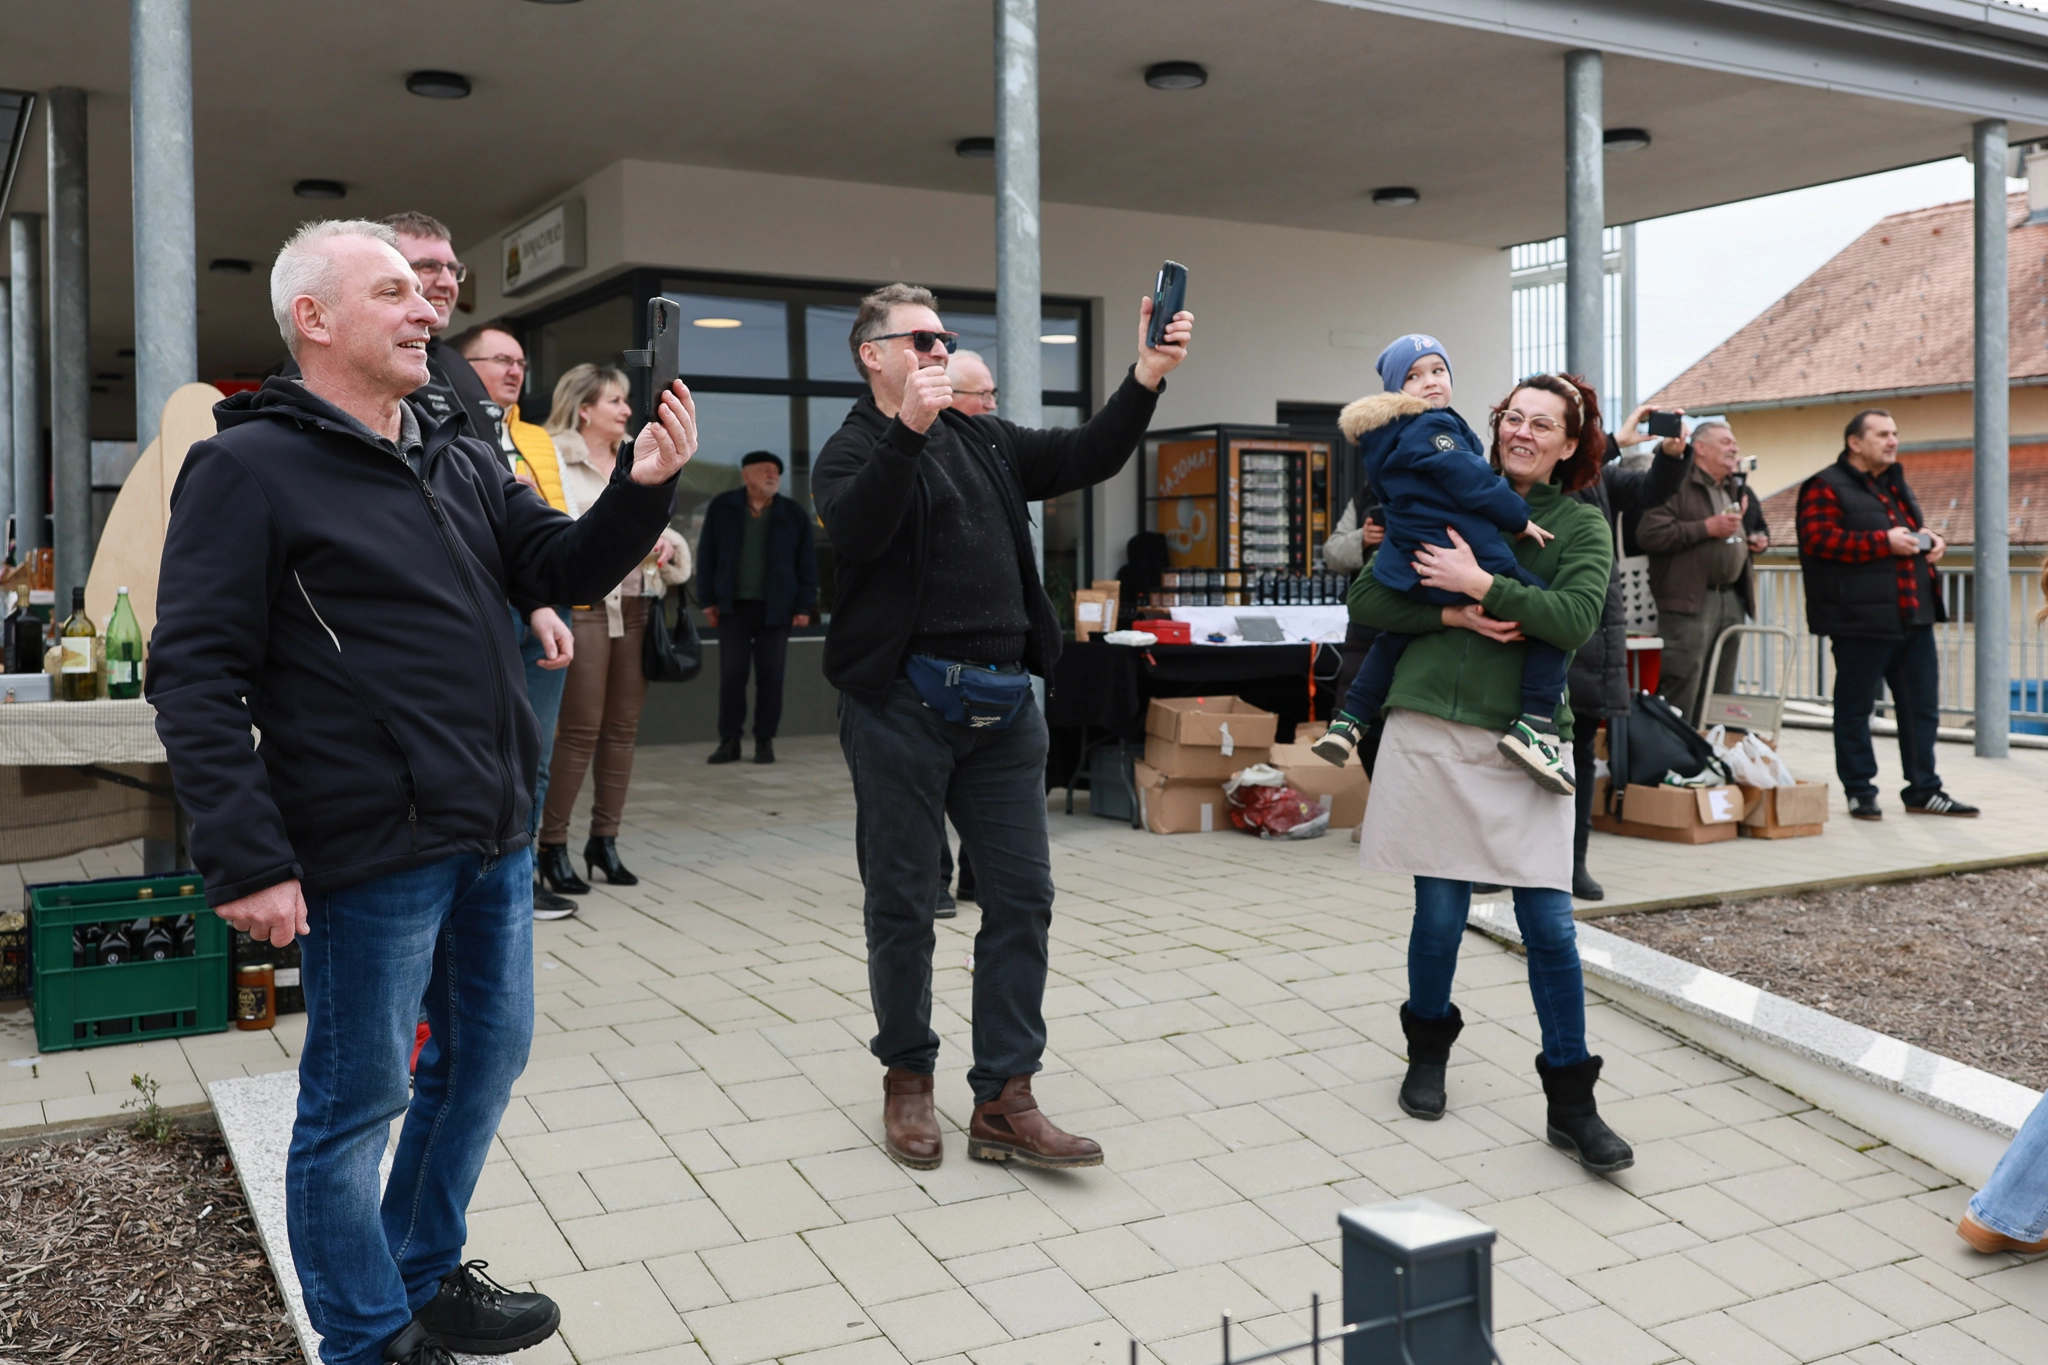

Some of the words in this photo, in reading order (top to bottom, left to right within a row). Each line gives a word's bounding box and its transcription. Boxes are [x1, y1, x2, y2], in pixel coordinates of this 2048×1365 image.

[1243, 456, 1250, 470] 1
[1158, 448, 1217, 499] JAJOMAT
[1242, 474, 1252, 489] 2
[1242, 492, 1252, 508] 3
[1242, 511, 1252, 526] 4
[1242, 530, 1252, 545] 5
[1242, 549, 1252, 564] 6
